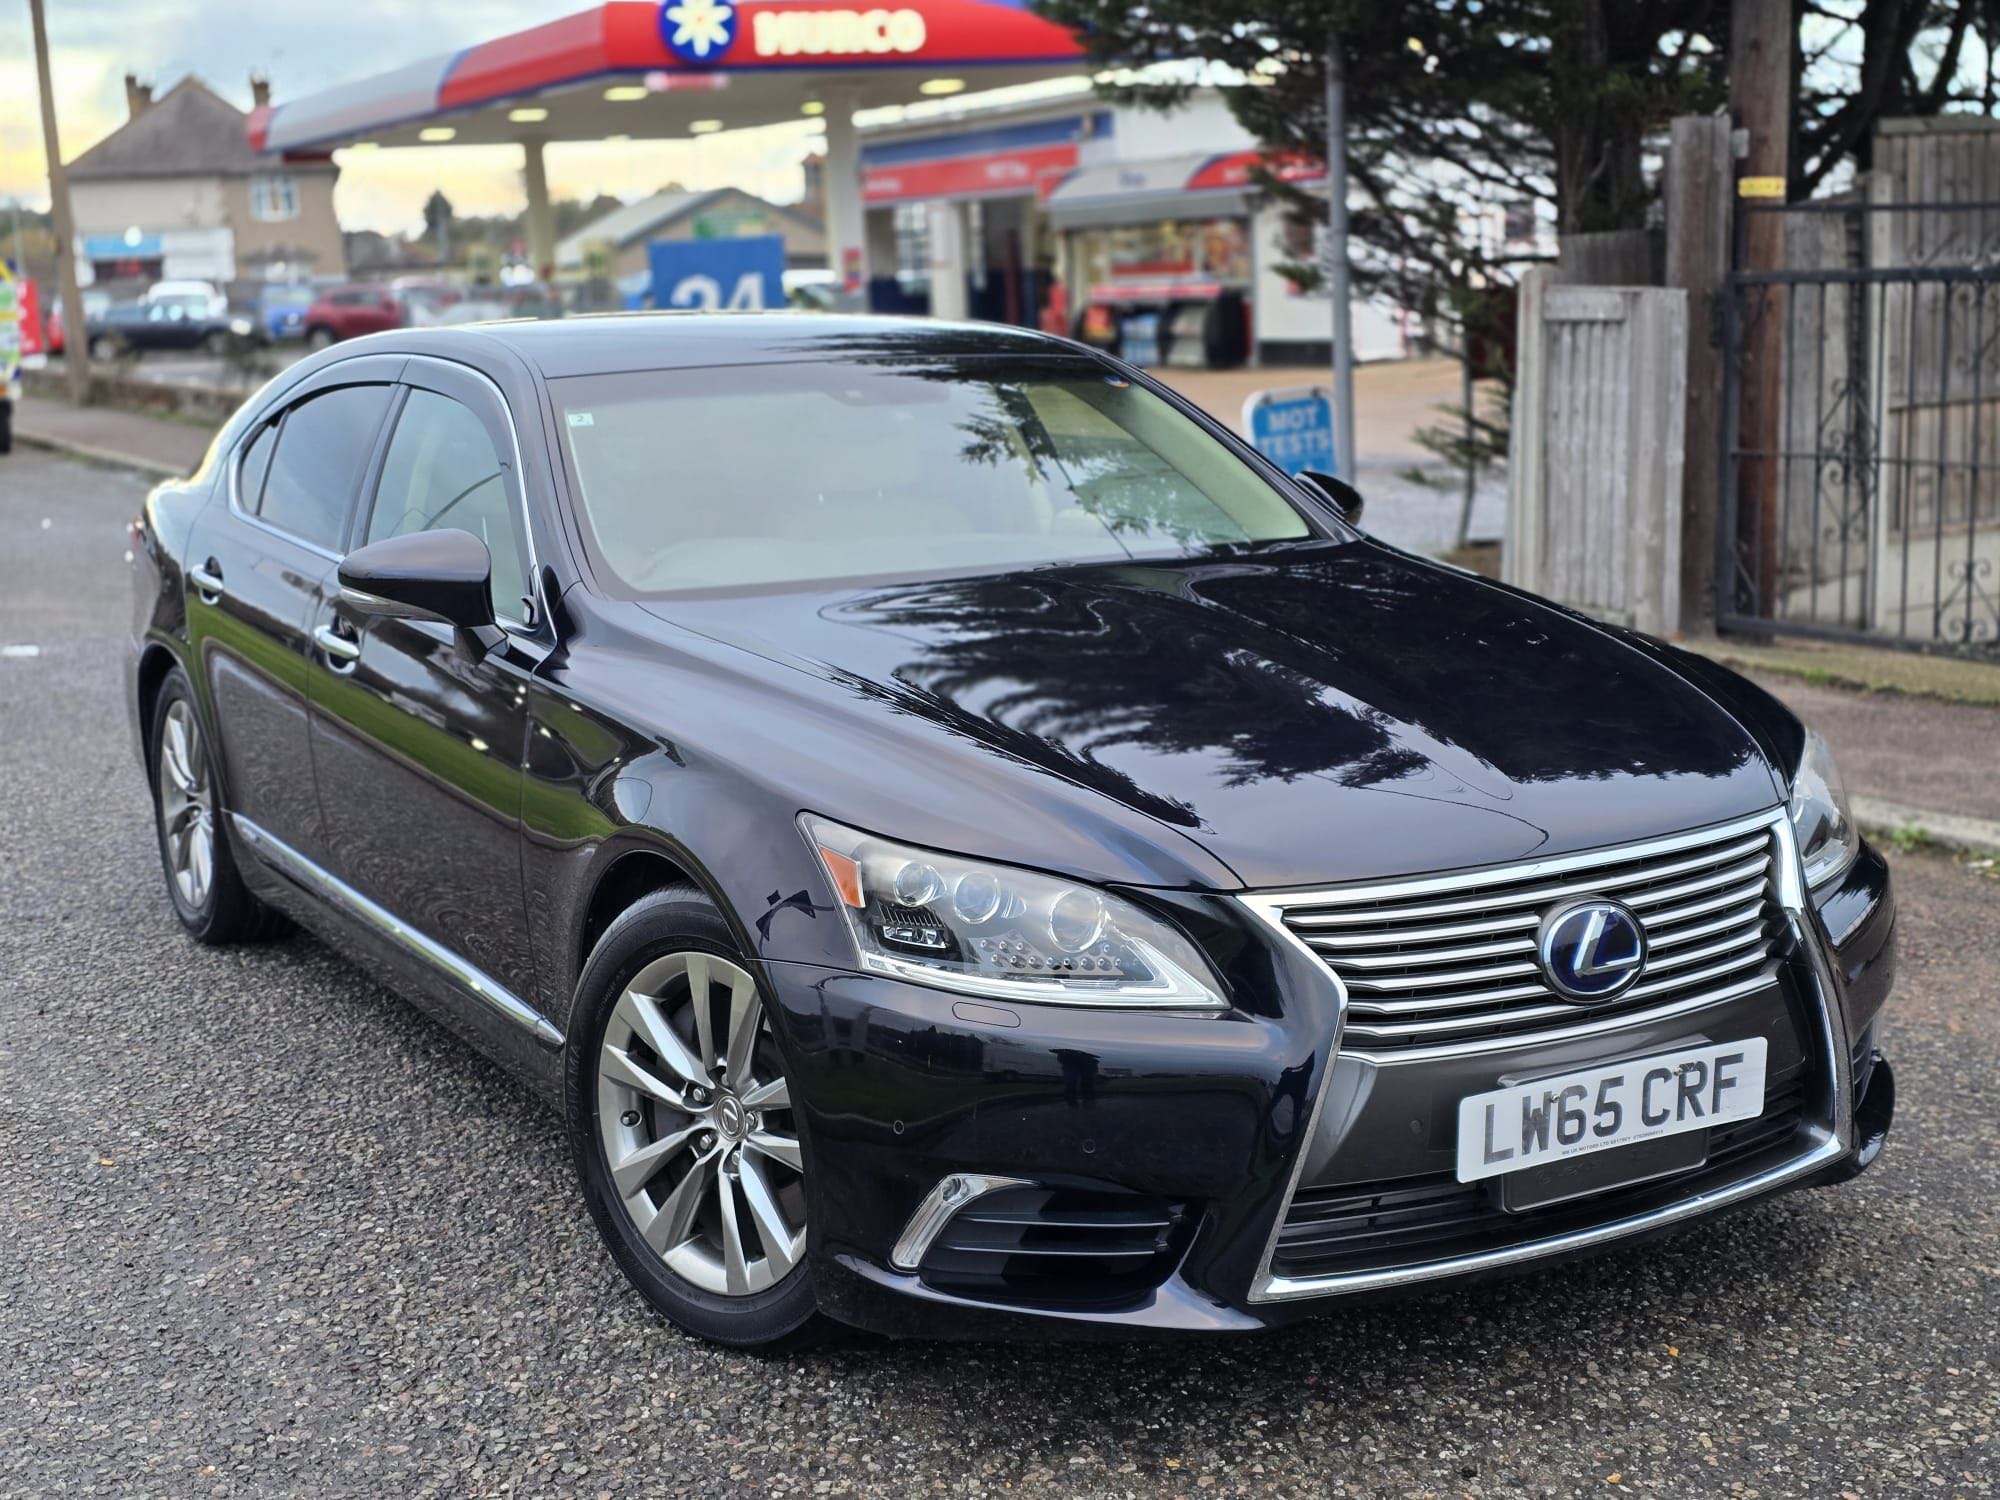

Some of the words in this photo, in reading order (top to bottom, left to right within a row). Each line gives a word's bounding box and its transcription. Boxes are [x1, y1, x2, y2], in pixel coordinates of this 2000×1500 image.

[670, 272, 764, 311] 24
[1269, 406, 1317, 433] MOT
[1259, 428, 1330, 459] TESTS
[1483, 1075, 1625, 1165] LW65
[1641, 1052, 1745, 1128] CRF
